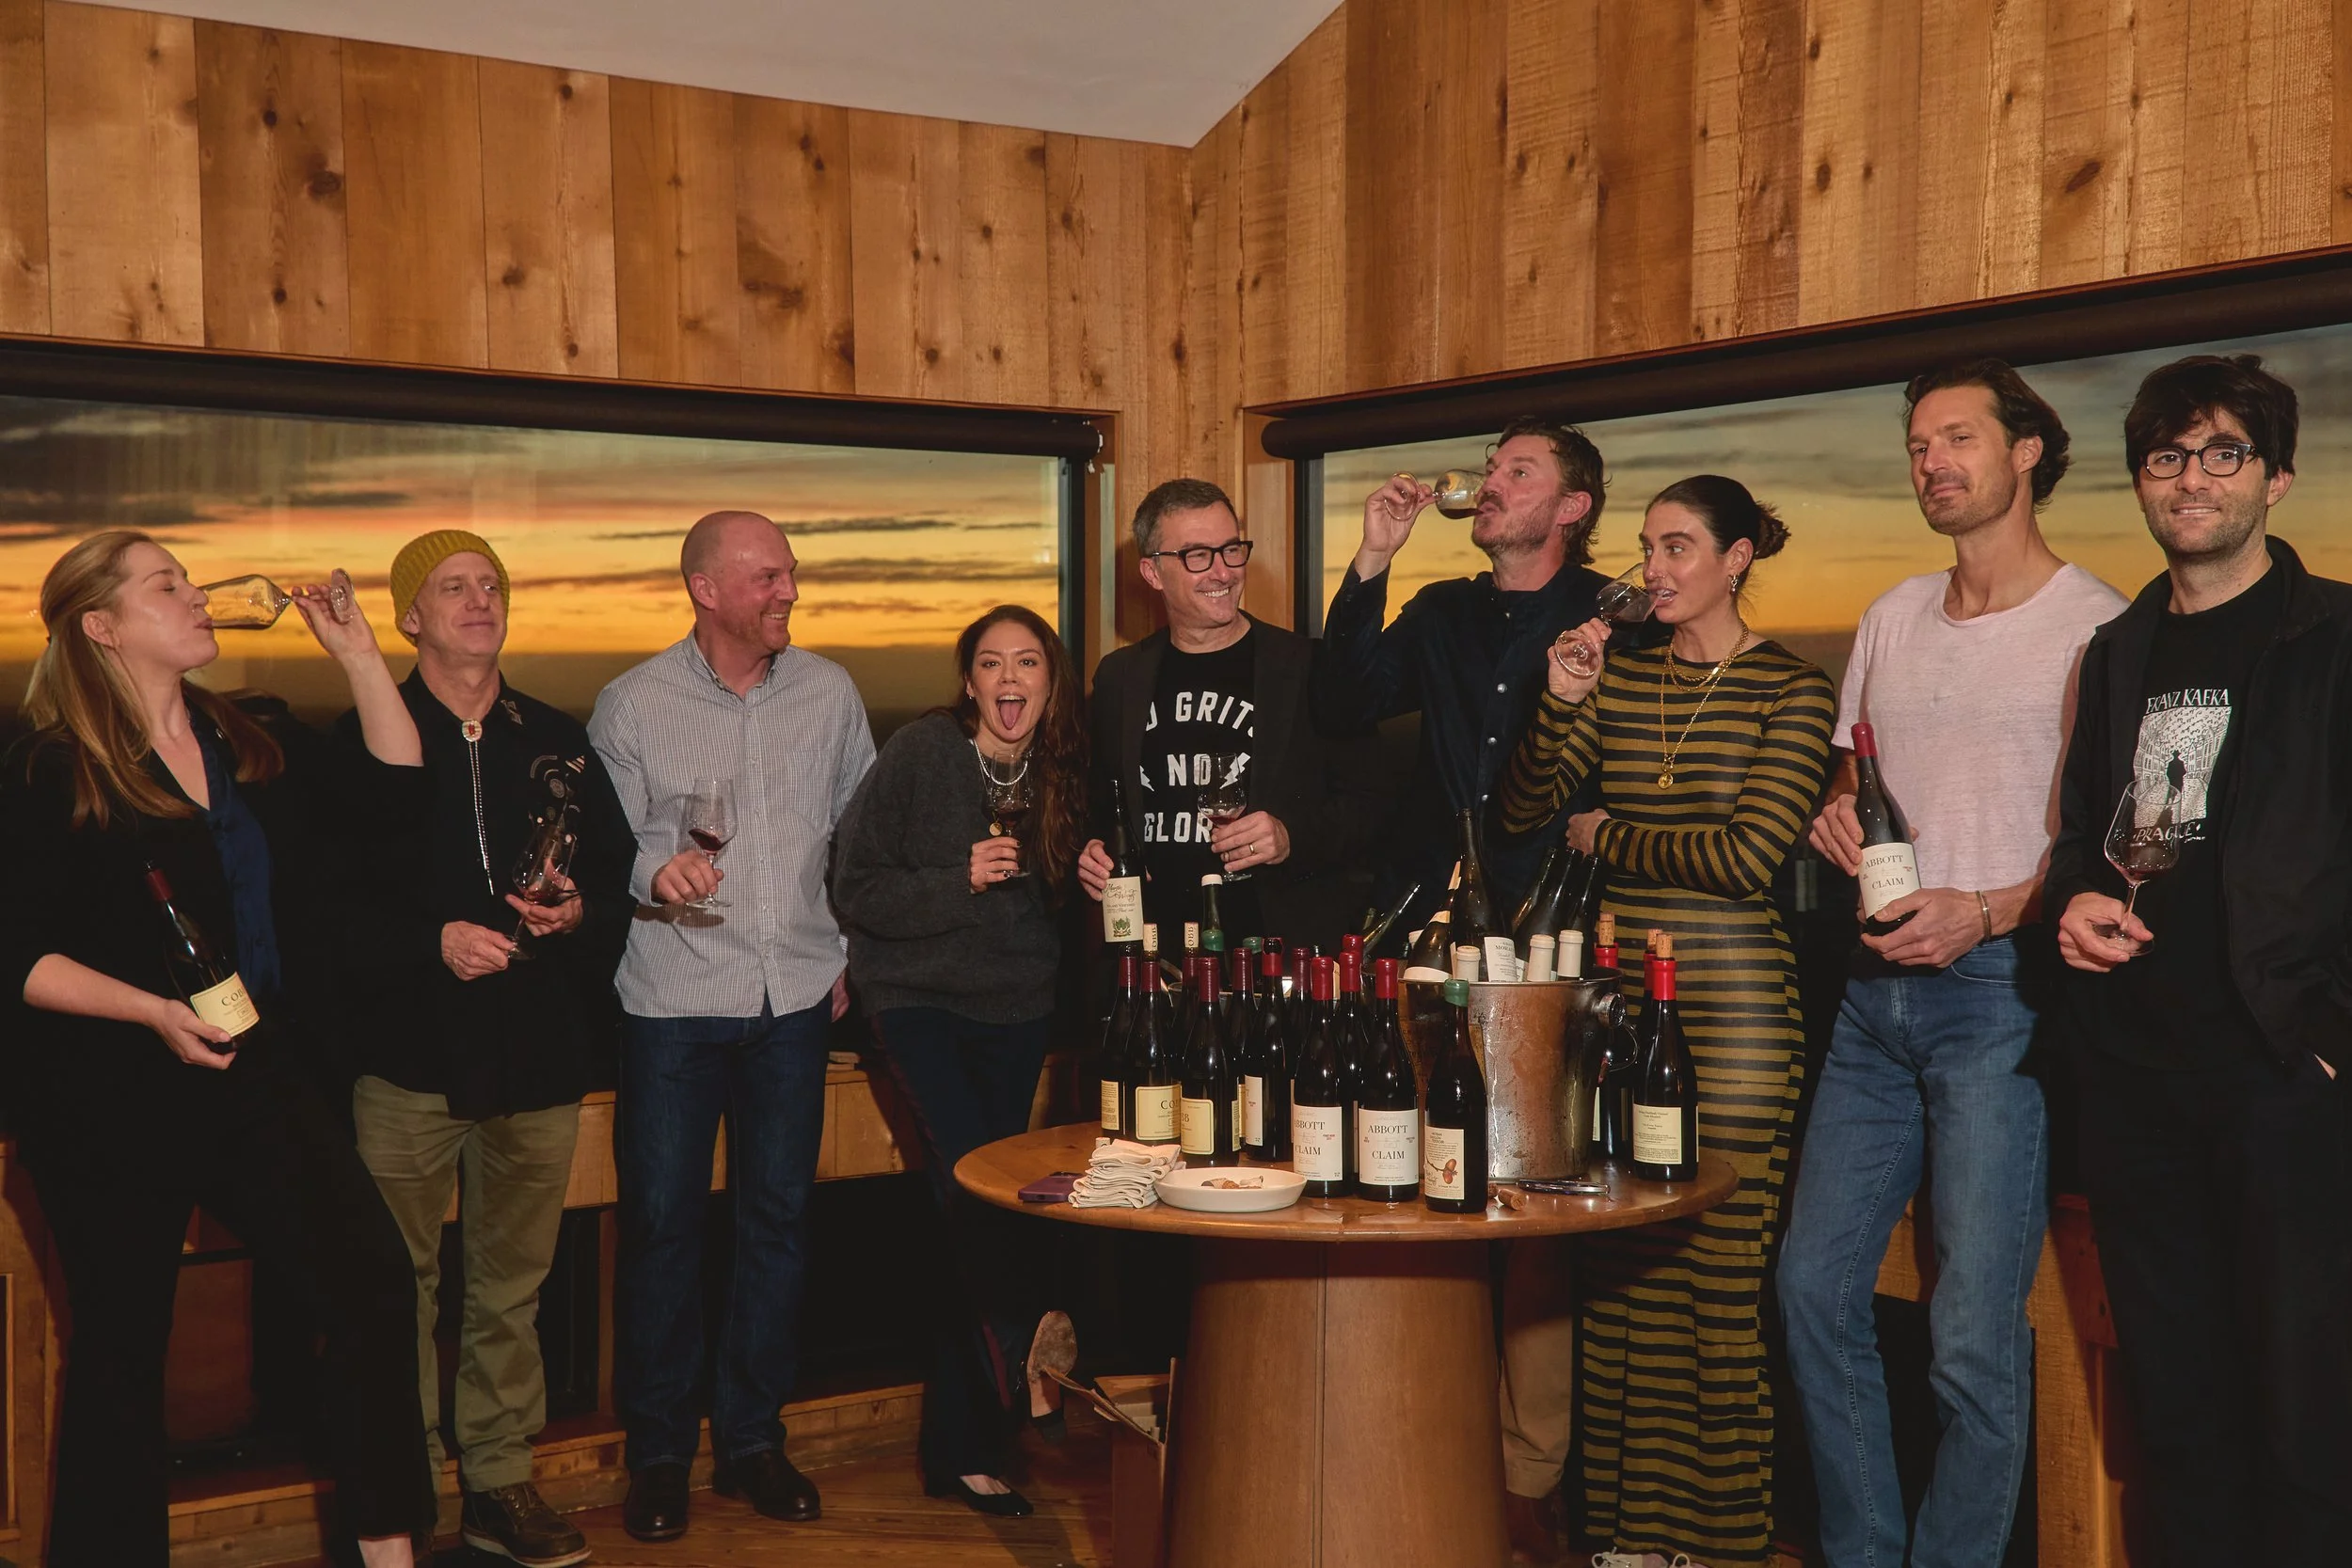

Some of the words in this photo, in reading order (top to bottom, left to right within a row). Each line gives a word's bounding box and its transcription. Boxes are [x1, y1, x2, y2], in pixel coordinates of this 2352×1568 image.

[2183, 688, 2231, 706] KAFKA
[1175, 690, 1254, 737] GRIT
[1167, 753, 1212, 786] NO
[1144, 812, 1214, 843] GLOR
[2136, 821, 2196, 844] PRAGUE
[1865, 855, 1903, 870] ABBOTT
[1872, 878, 1904, 890] CLAIM
[1367, 1124, 1408, 1134] ABBOTT
[1372, 1150, 1405, 1160] CLAIM
